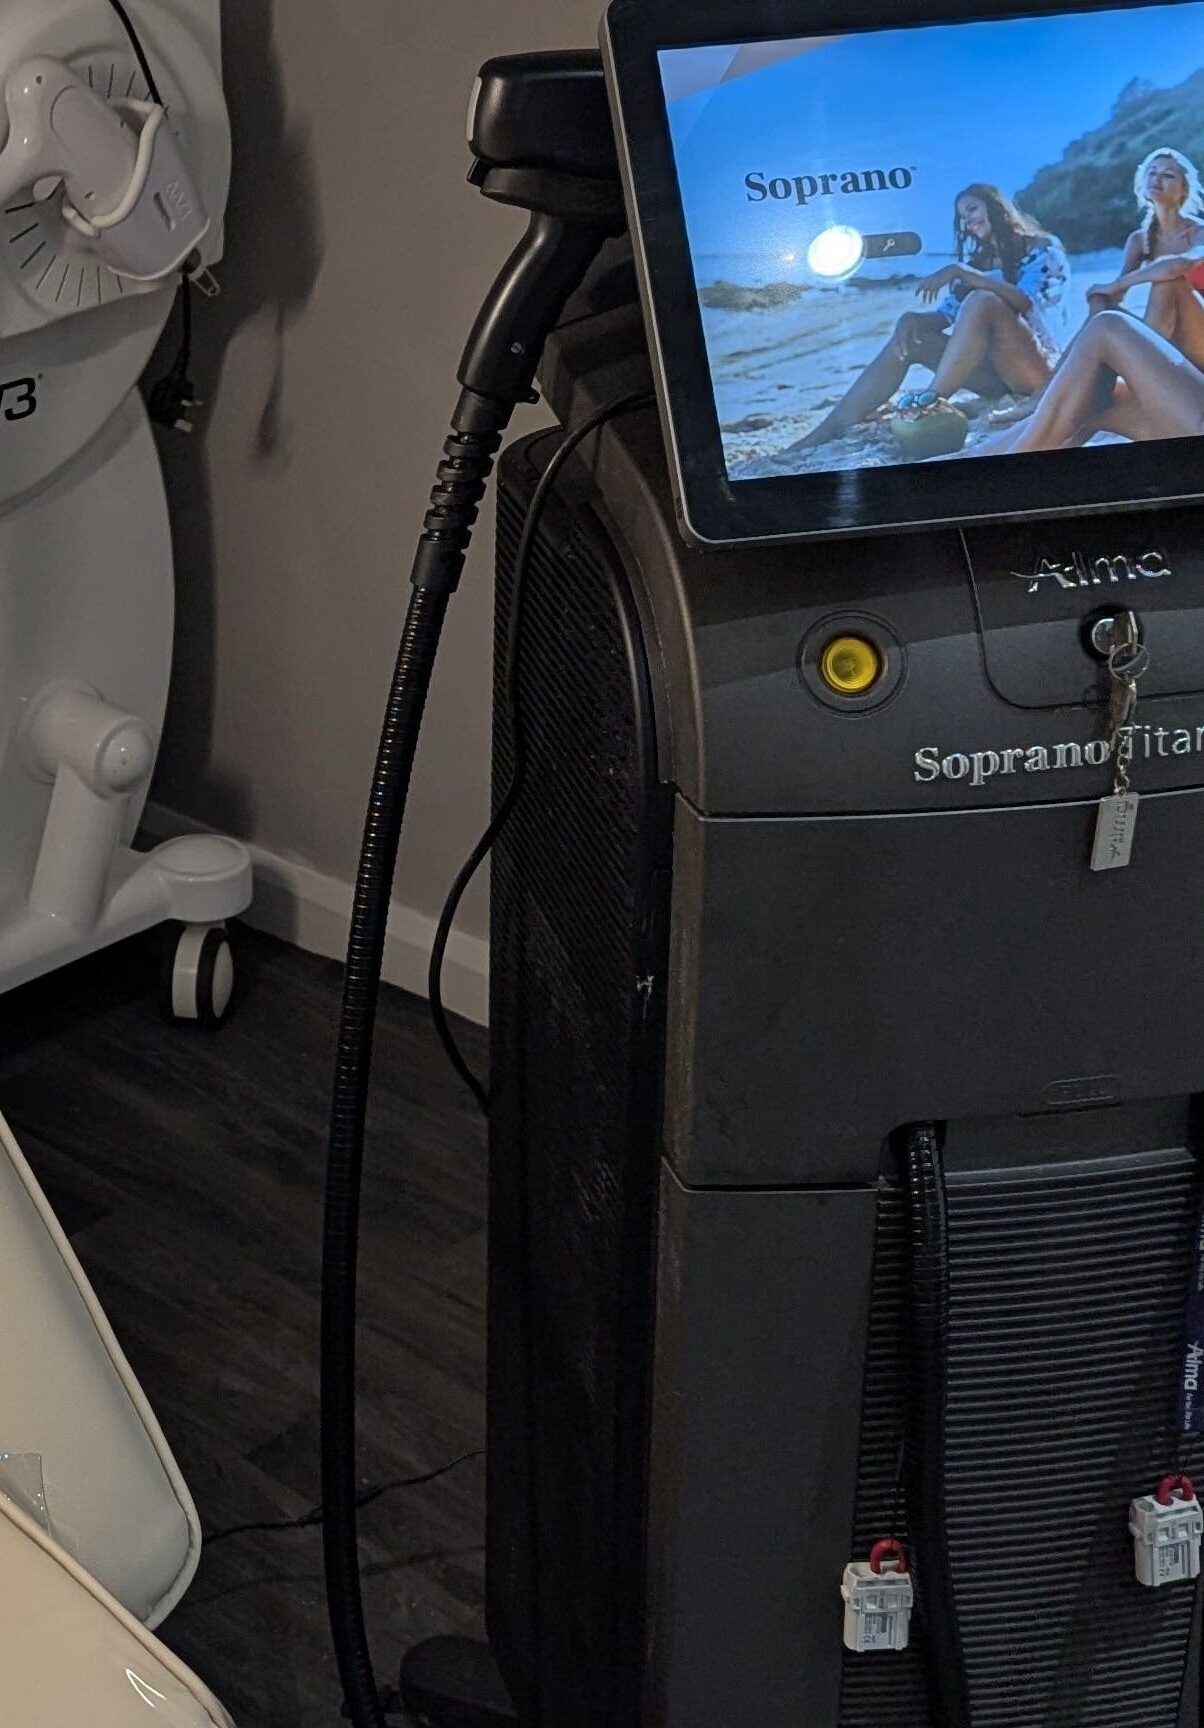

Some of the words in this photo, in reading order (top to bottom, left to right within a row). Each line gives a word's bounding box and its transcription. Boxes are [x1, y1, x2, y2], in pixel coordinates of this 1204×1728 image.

[745, 166, 913, 206] Soprano
[1010, 551, 1172, 593] Alma
[914, 740, 1111, 787] Soprano
[1184, 1340, 1204, 1391] Alma
